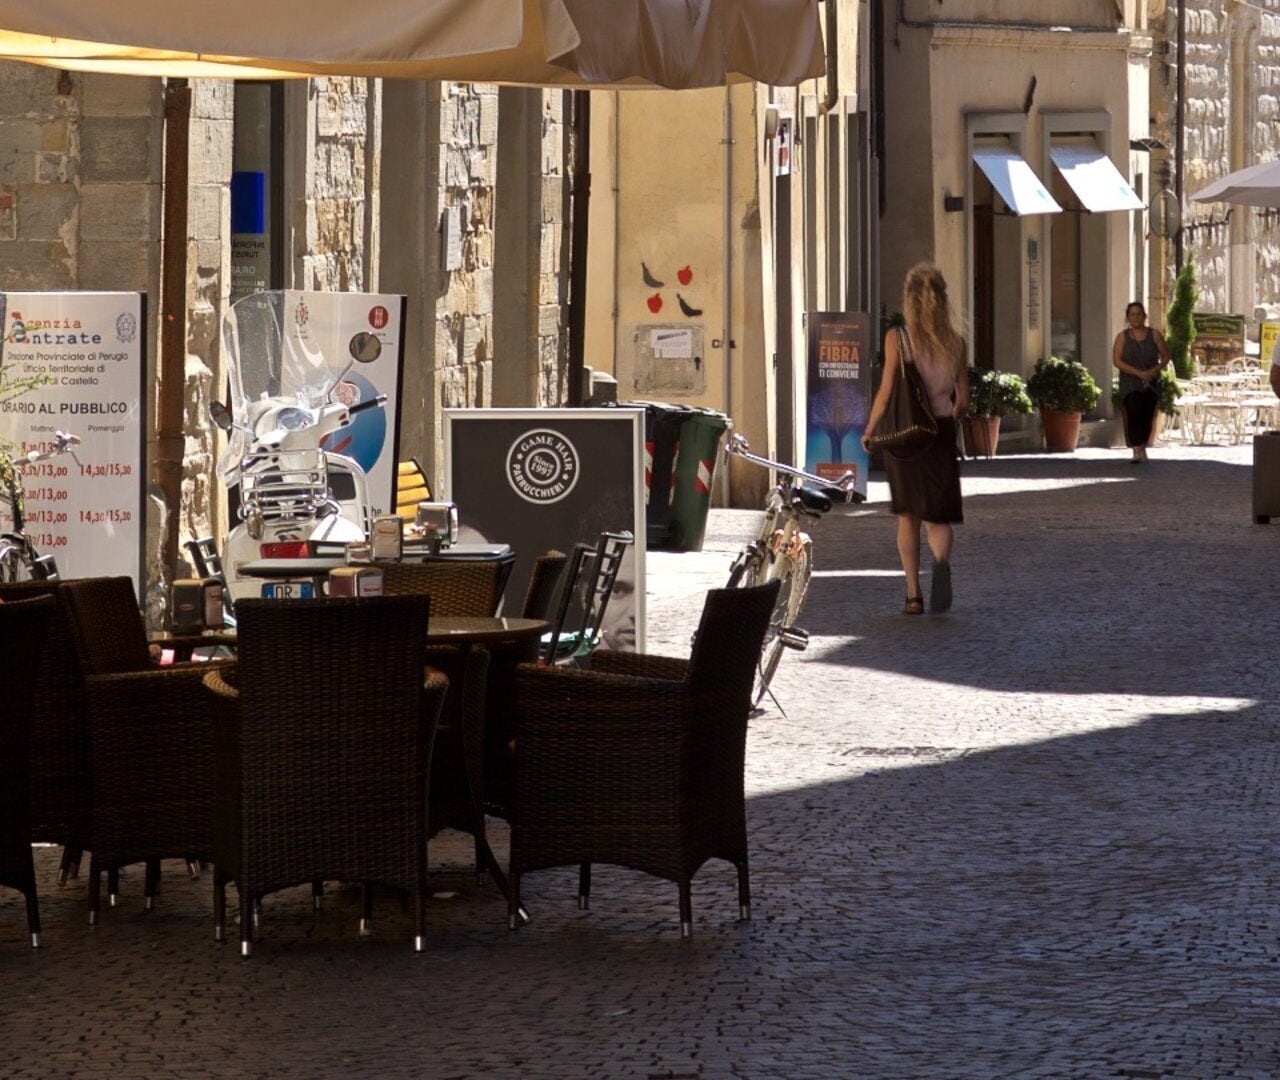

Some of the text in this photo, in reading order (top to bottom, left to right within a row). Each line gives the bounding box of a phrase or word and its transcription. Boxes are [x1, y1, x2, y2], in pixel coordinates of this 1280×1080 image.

[36, 352, 86, 361] Provinciale
[87, 352, 97, 361] di
[99, 352, 128, 362] Perugia
[819, 346, 859, 361] FIBRA
[48, 364, 96, 373] Territoriale
[97, 364, 106, 373] di
[819, 368, 859, 379] TI CONVIENE
[60, 376, 100, 386] Castello
[2, 401, 128, 414] ORARIO AL PUBBLICO
[520, 435, 574, 471] GAME HAIR
[533, 455, 555, 470] Since
[530, 462, 552, 478] 1997
[512, 463, 566, 498] PARRUCCHIERI
